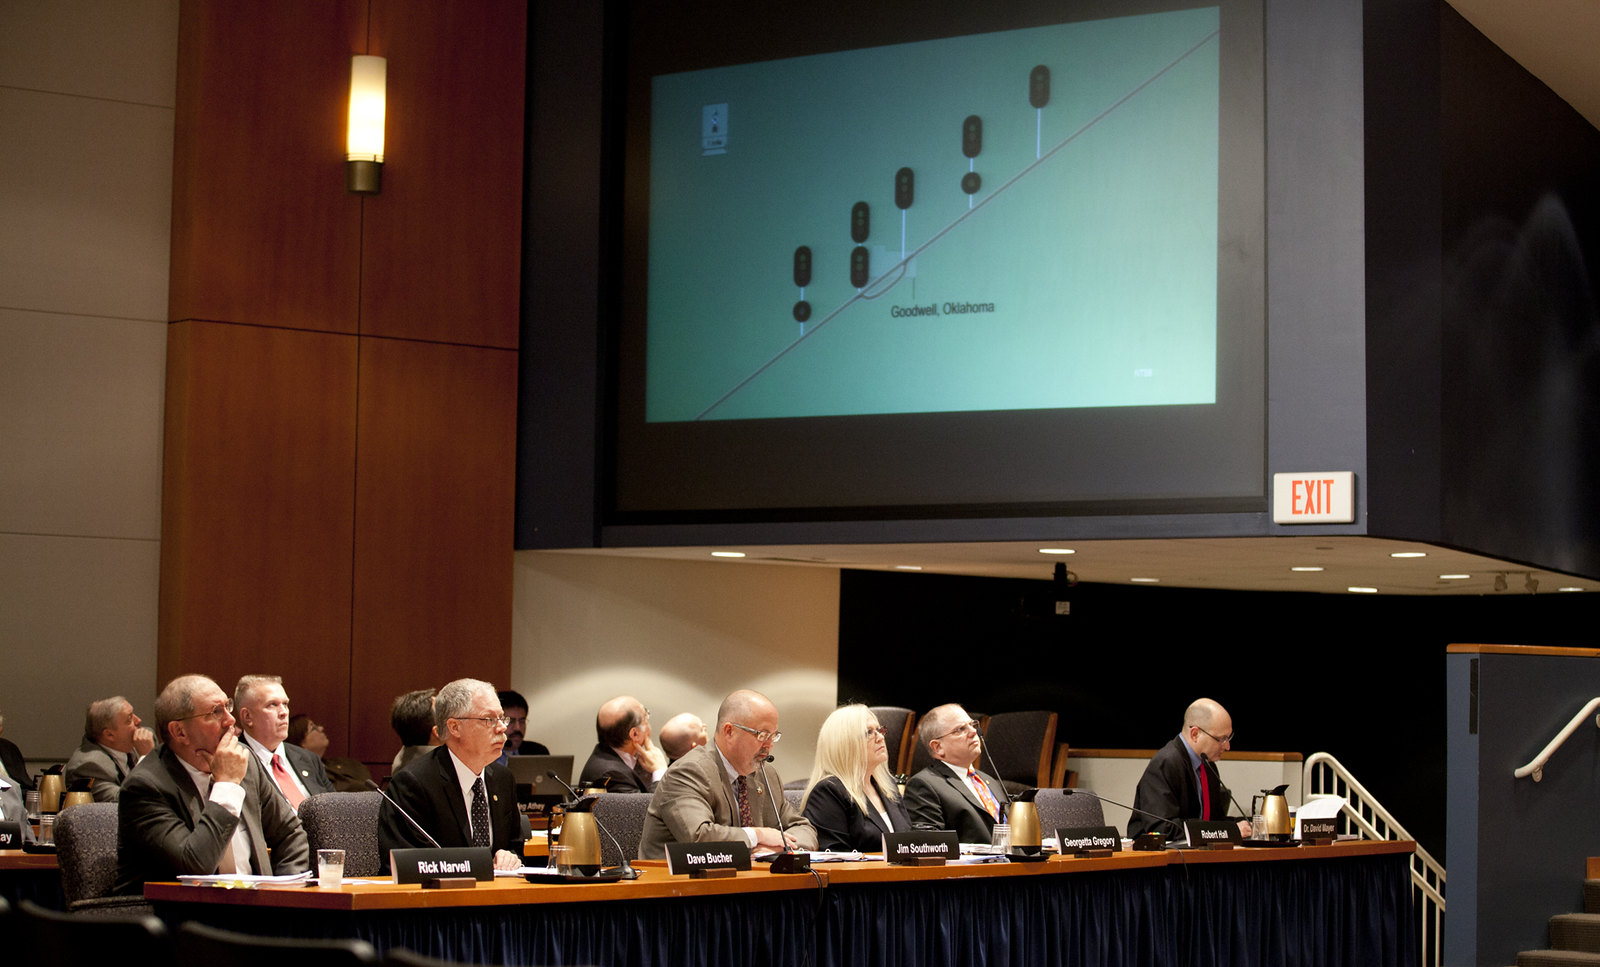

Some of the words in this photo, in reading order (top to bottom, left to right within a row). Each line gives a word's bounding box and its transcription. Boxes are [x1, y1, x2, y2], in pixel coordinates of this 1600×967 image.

[890, 304, 940, 318] Goodwell,
[943, 302, 995, 315] Oklahoma
[1291, 479, 1335, 515] EXIT
[1200, 829, 1218, 839] Robert
[1218, 829, 1229, 839] Hall
[897, 843, 909, 854] Jim
[909, 842, 949, 854] Southworth
[1064, 837, 1092, 849] Georgetta
[1092, 836, 1115, 847] Gregory
[686, 853, 706, 865] Dave
[706, 852, 733, 864] Bucher
[417, 861, 439, 874] Rick
[439, 860, 471, 873] Narvell
